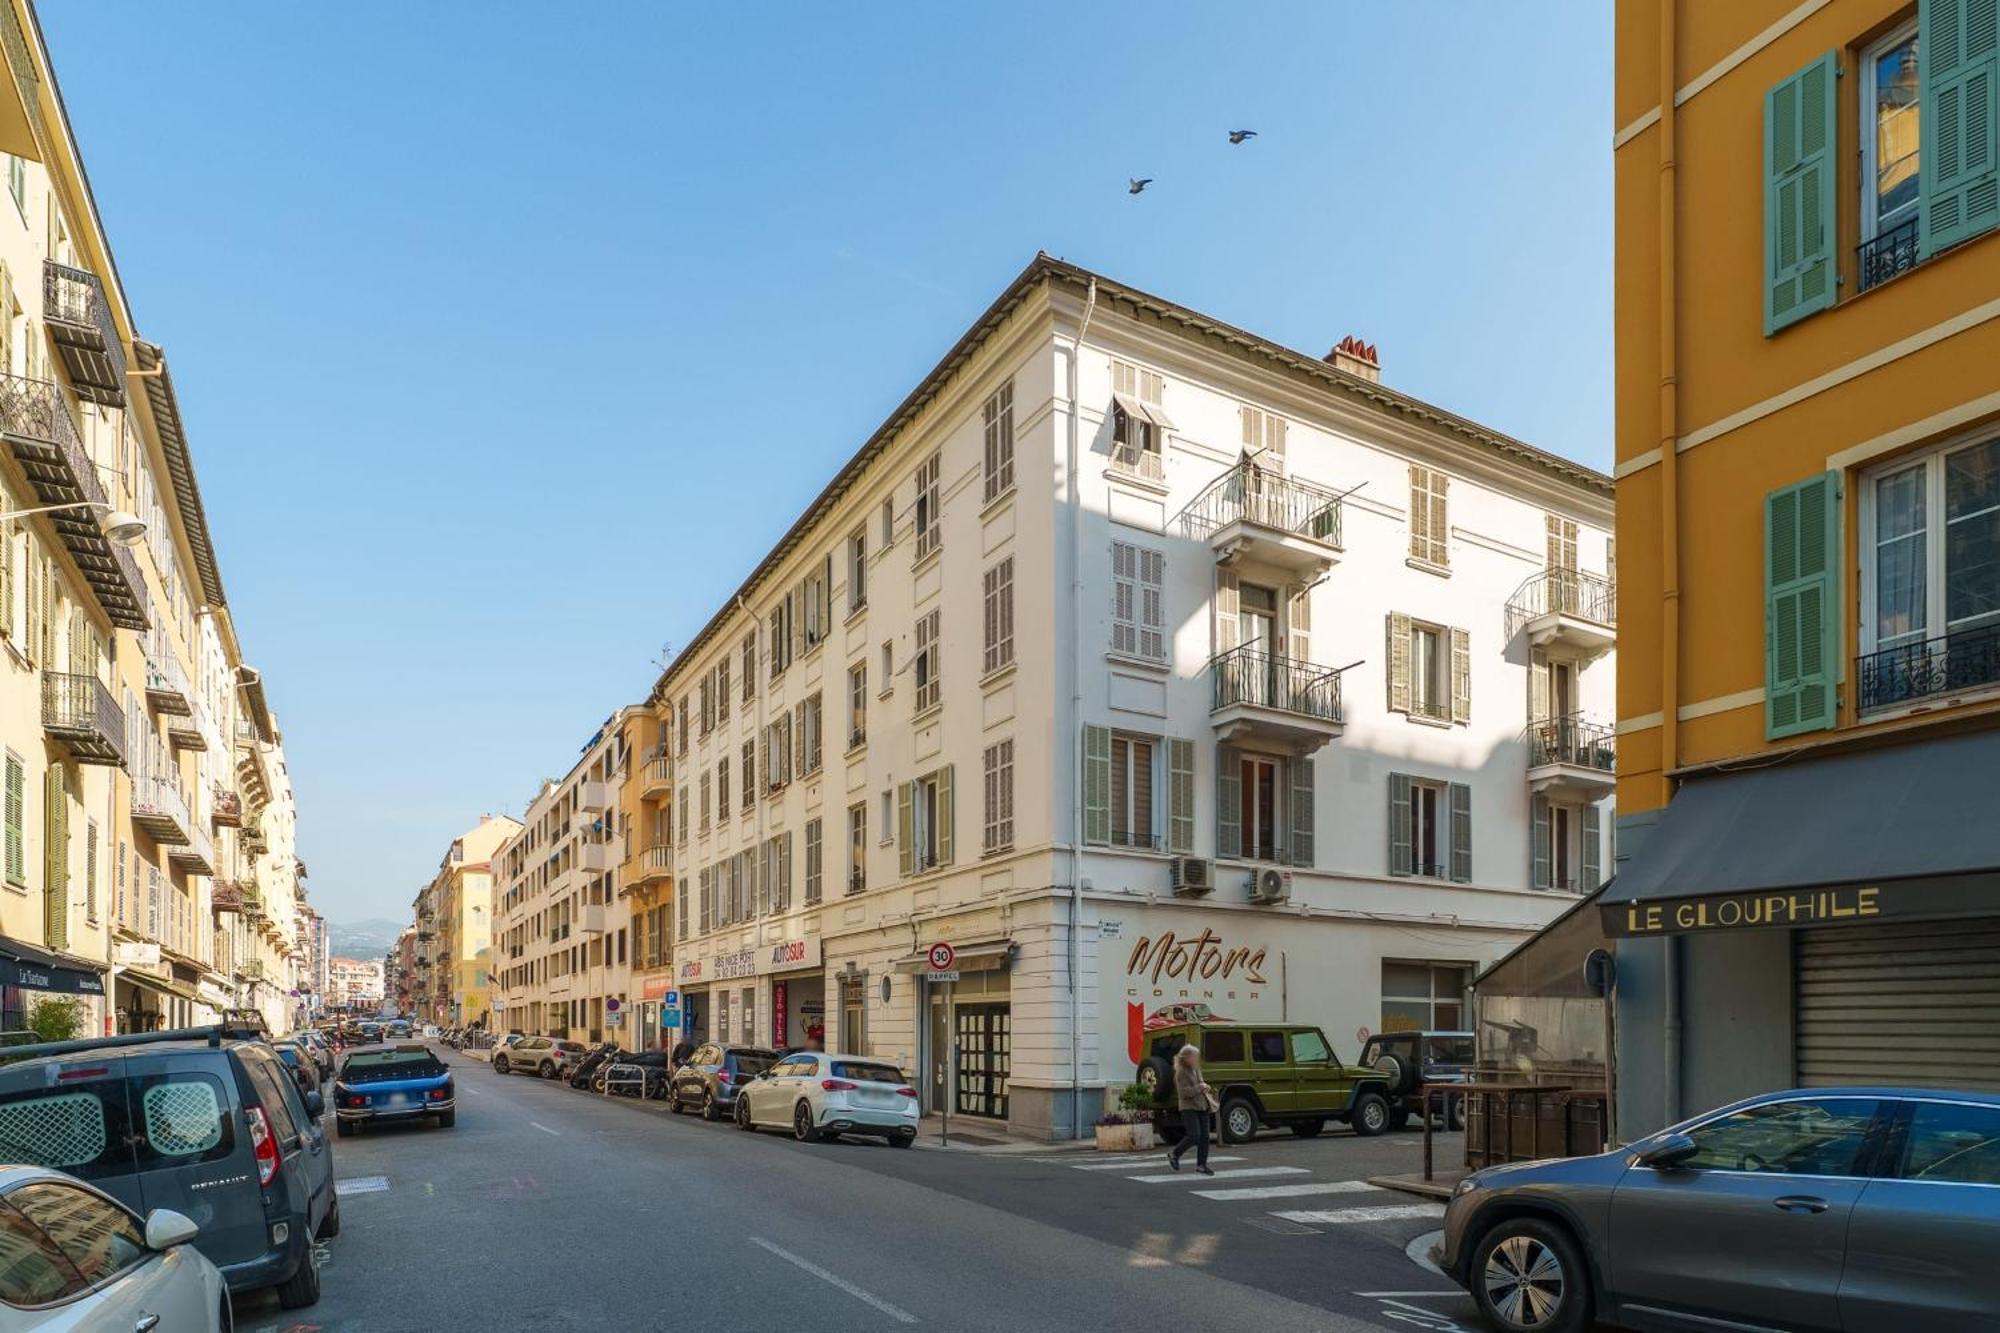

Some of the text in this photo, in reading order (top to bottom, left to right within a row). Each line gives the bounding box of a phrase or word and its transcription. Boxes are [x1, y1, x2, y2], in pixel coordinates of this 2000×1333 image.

[1628, 888, 1880, 931] LE GLOUPHILE
[771, 941, 805, 965] AUTOSUR
[934, 951, 949, 961] 30
[1127, 927, 1267, 985] Motors
[681, 960, 702, 978] AUTOSUR
[1127, 988, 1259, 1000] CORNER
